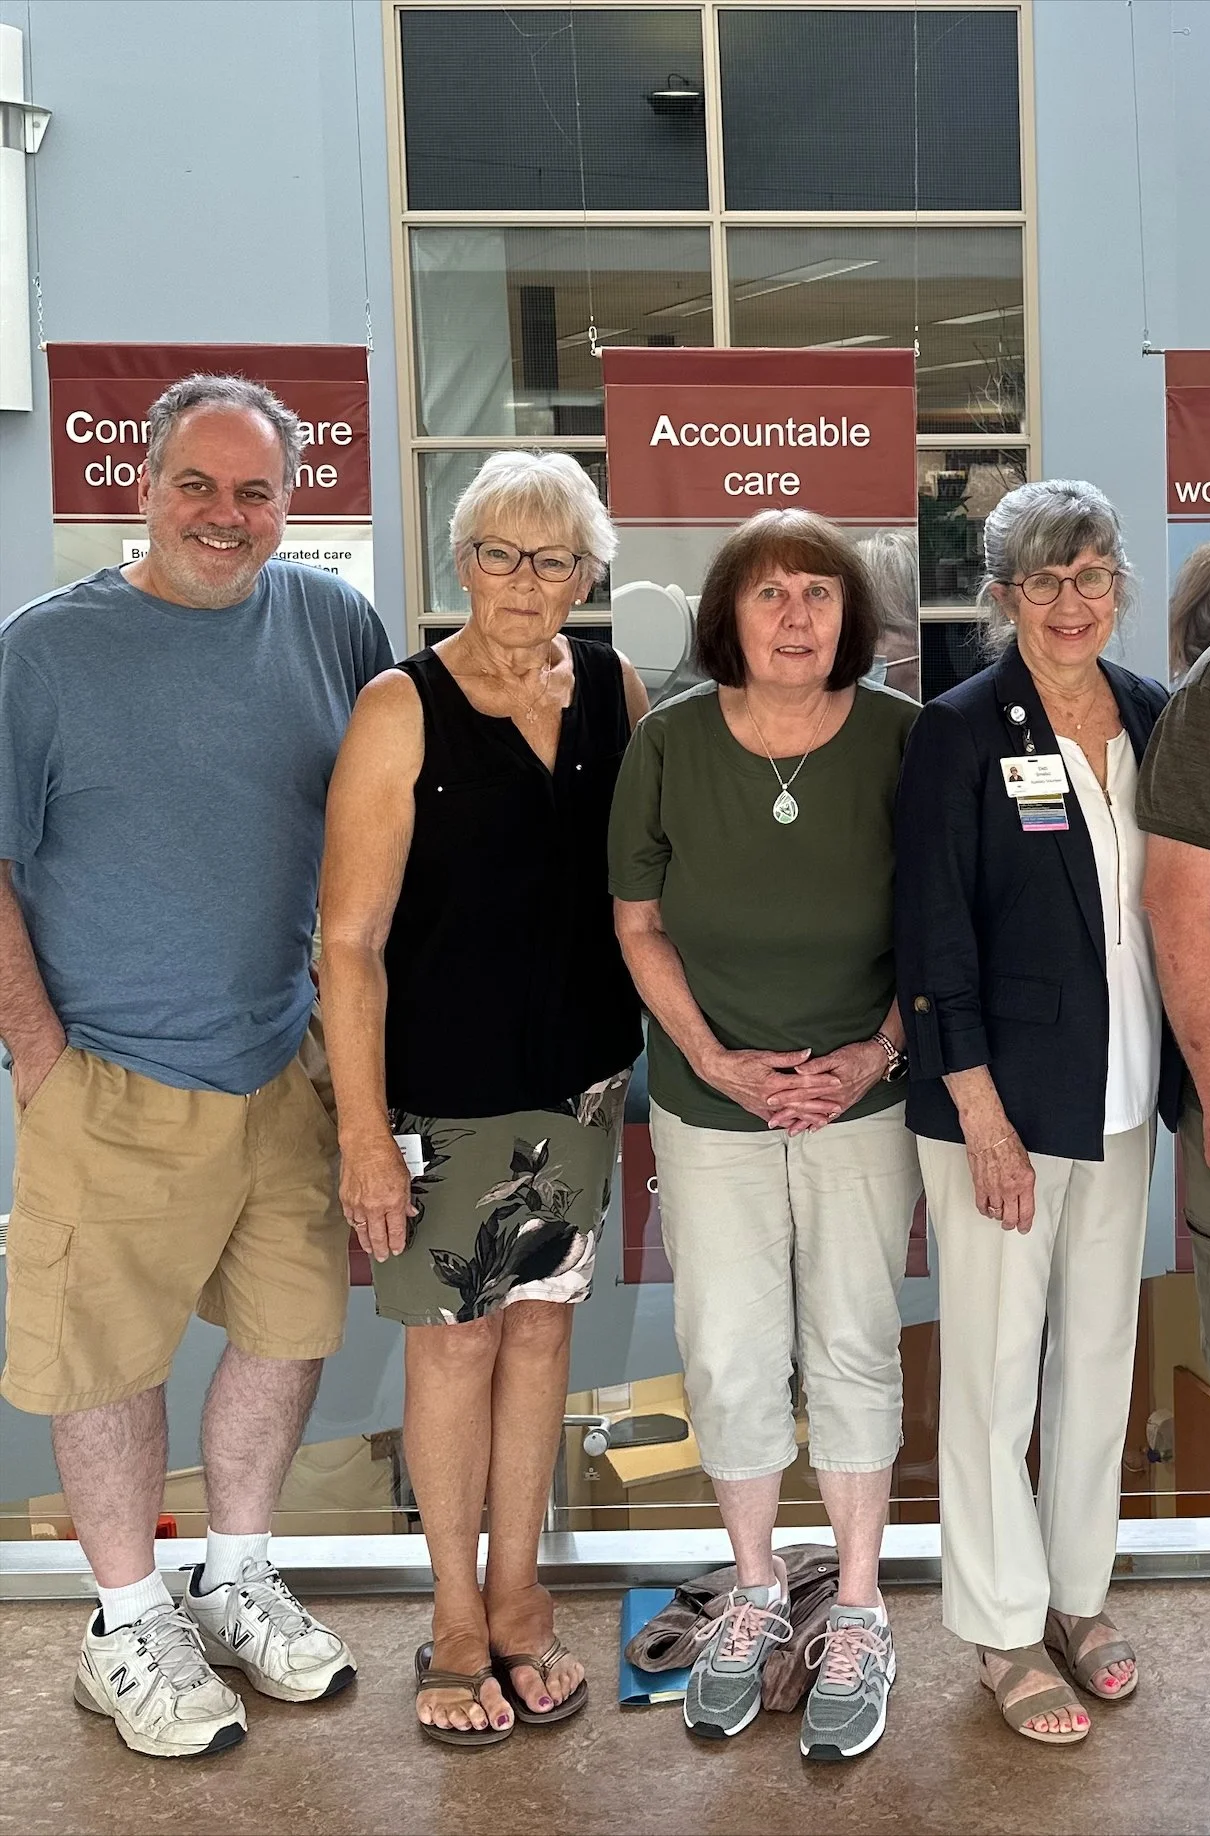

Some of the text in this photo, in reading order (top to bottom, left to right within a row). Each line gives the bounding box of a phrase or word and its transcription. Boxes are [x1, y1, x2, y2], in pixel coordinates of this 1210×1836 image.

[297, 421, 353, 446] are
[649, 414, 871, 447] Accountable
[85, 455, 143, 487] clo
[723, 471, 801, 496] care
[323, 551, 352, 560] care
